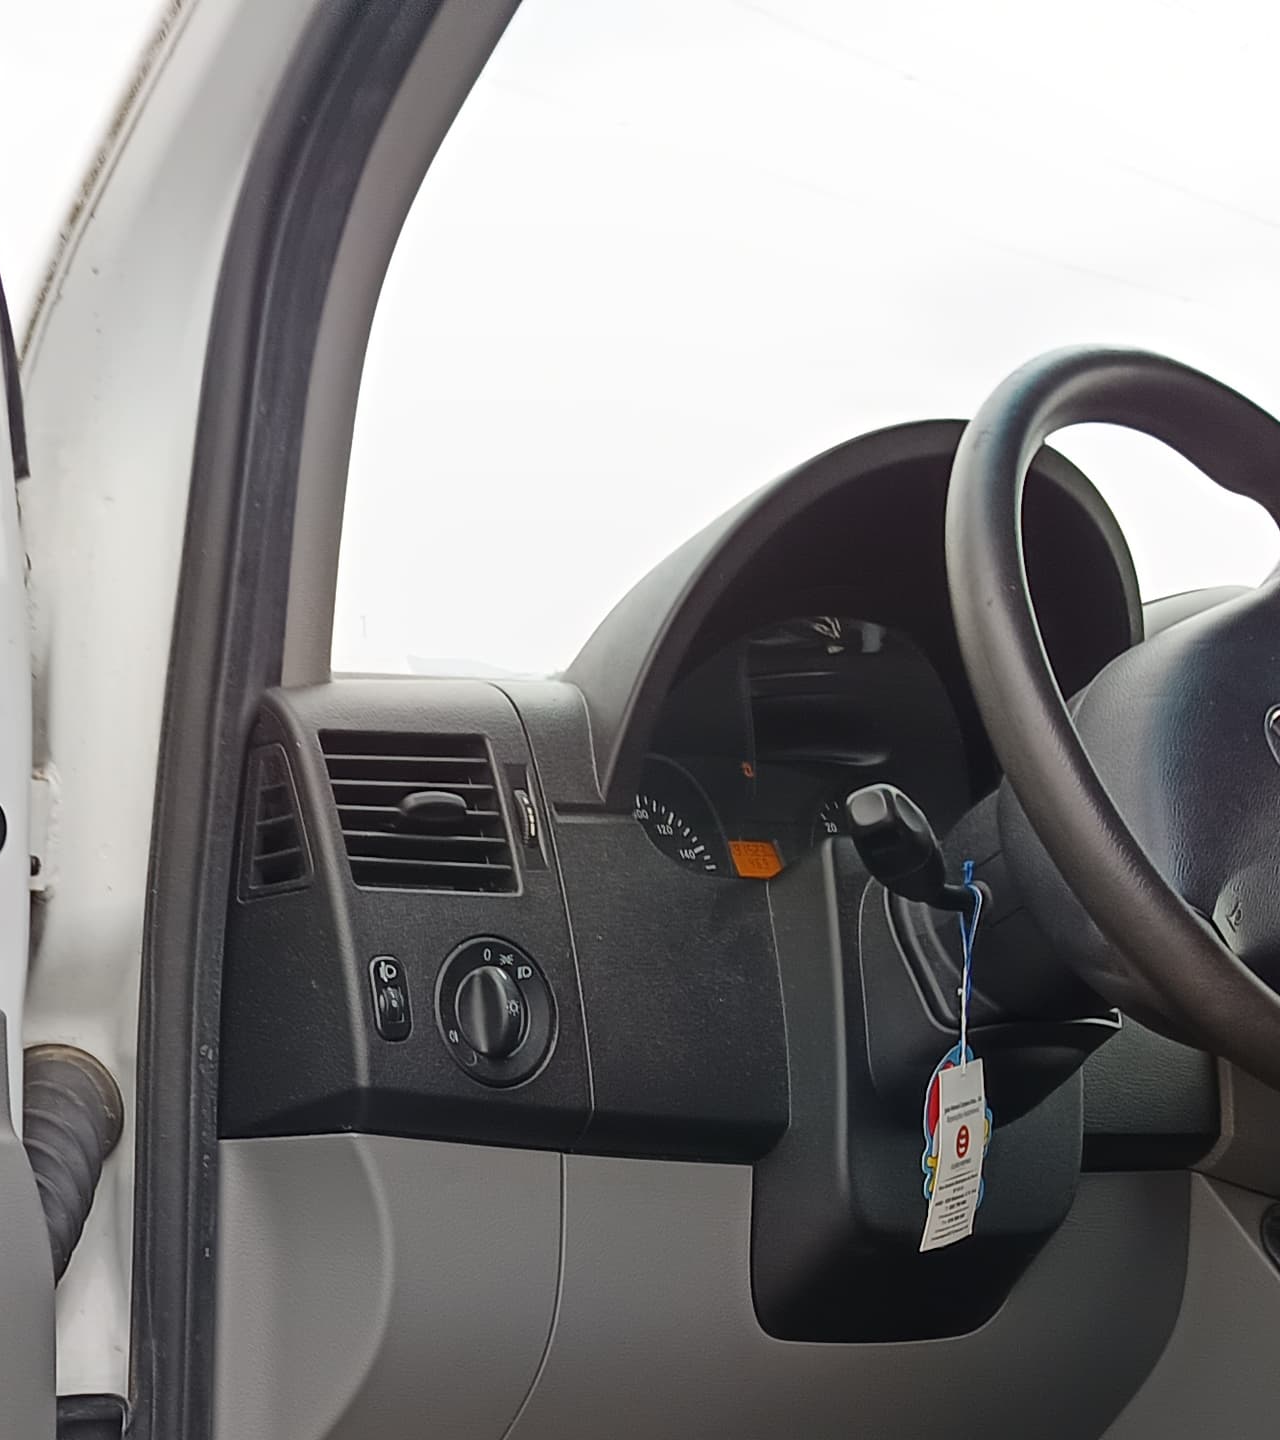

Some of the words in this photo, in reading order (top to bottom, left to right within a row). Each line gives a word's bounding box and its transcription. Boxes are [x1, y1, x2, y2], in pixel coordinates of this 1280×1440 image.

[657, 824, 673, 835] 120
[825, 822, 838, 833] 20
[680, 849, 696, 860] 140
[483, 948, 492, 962] 0
